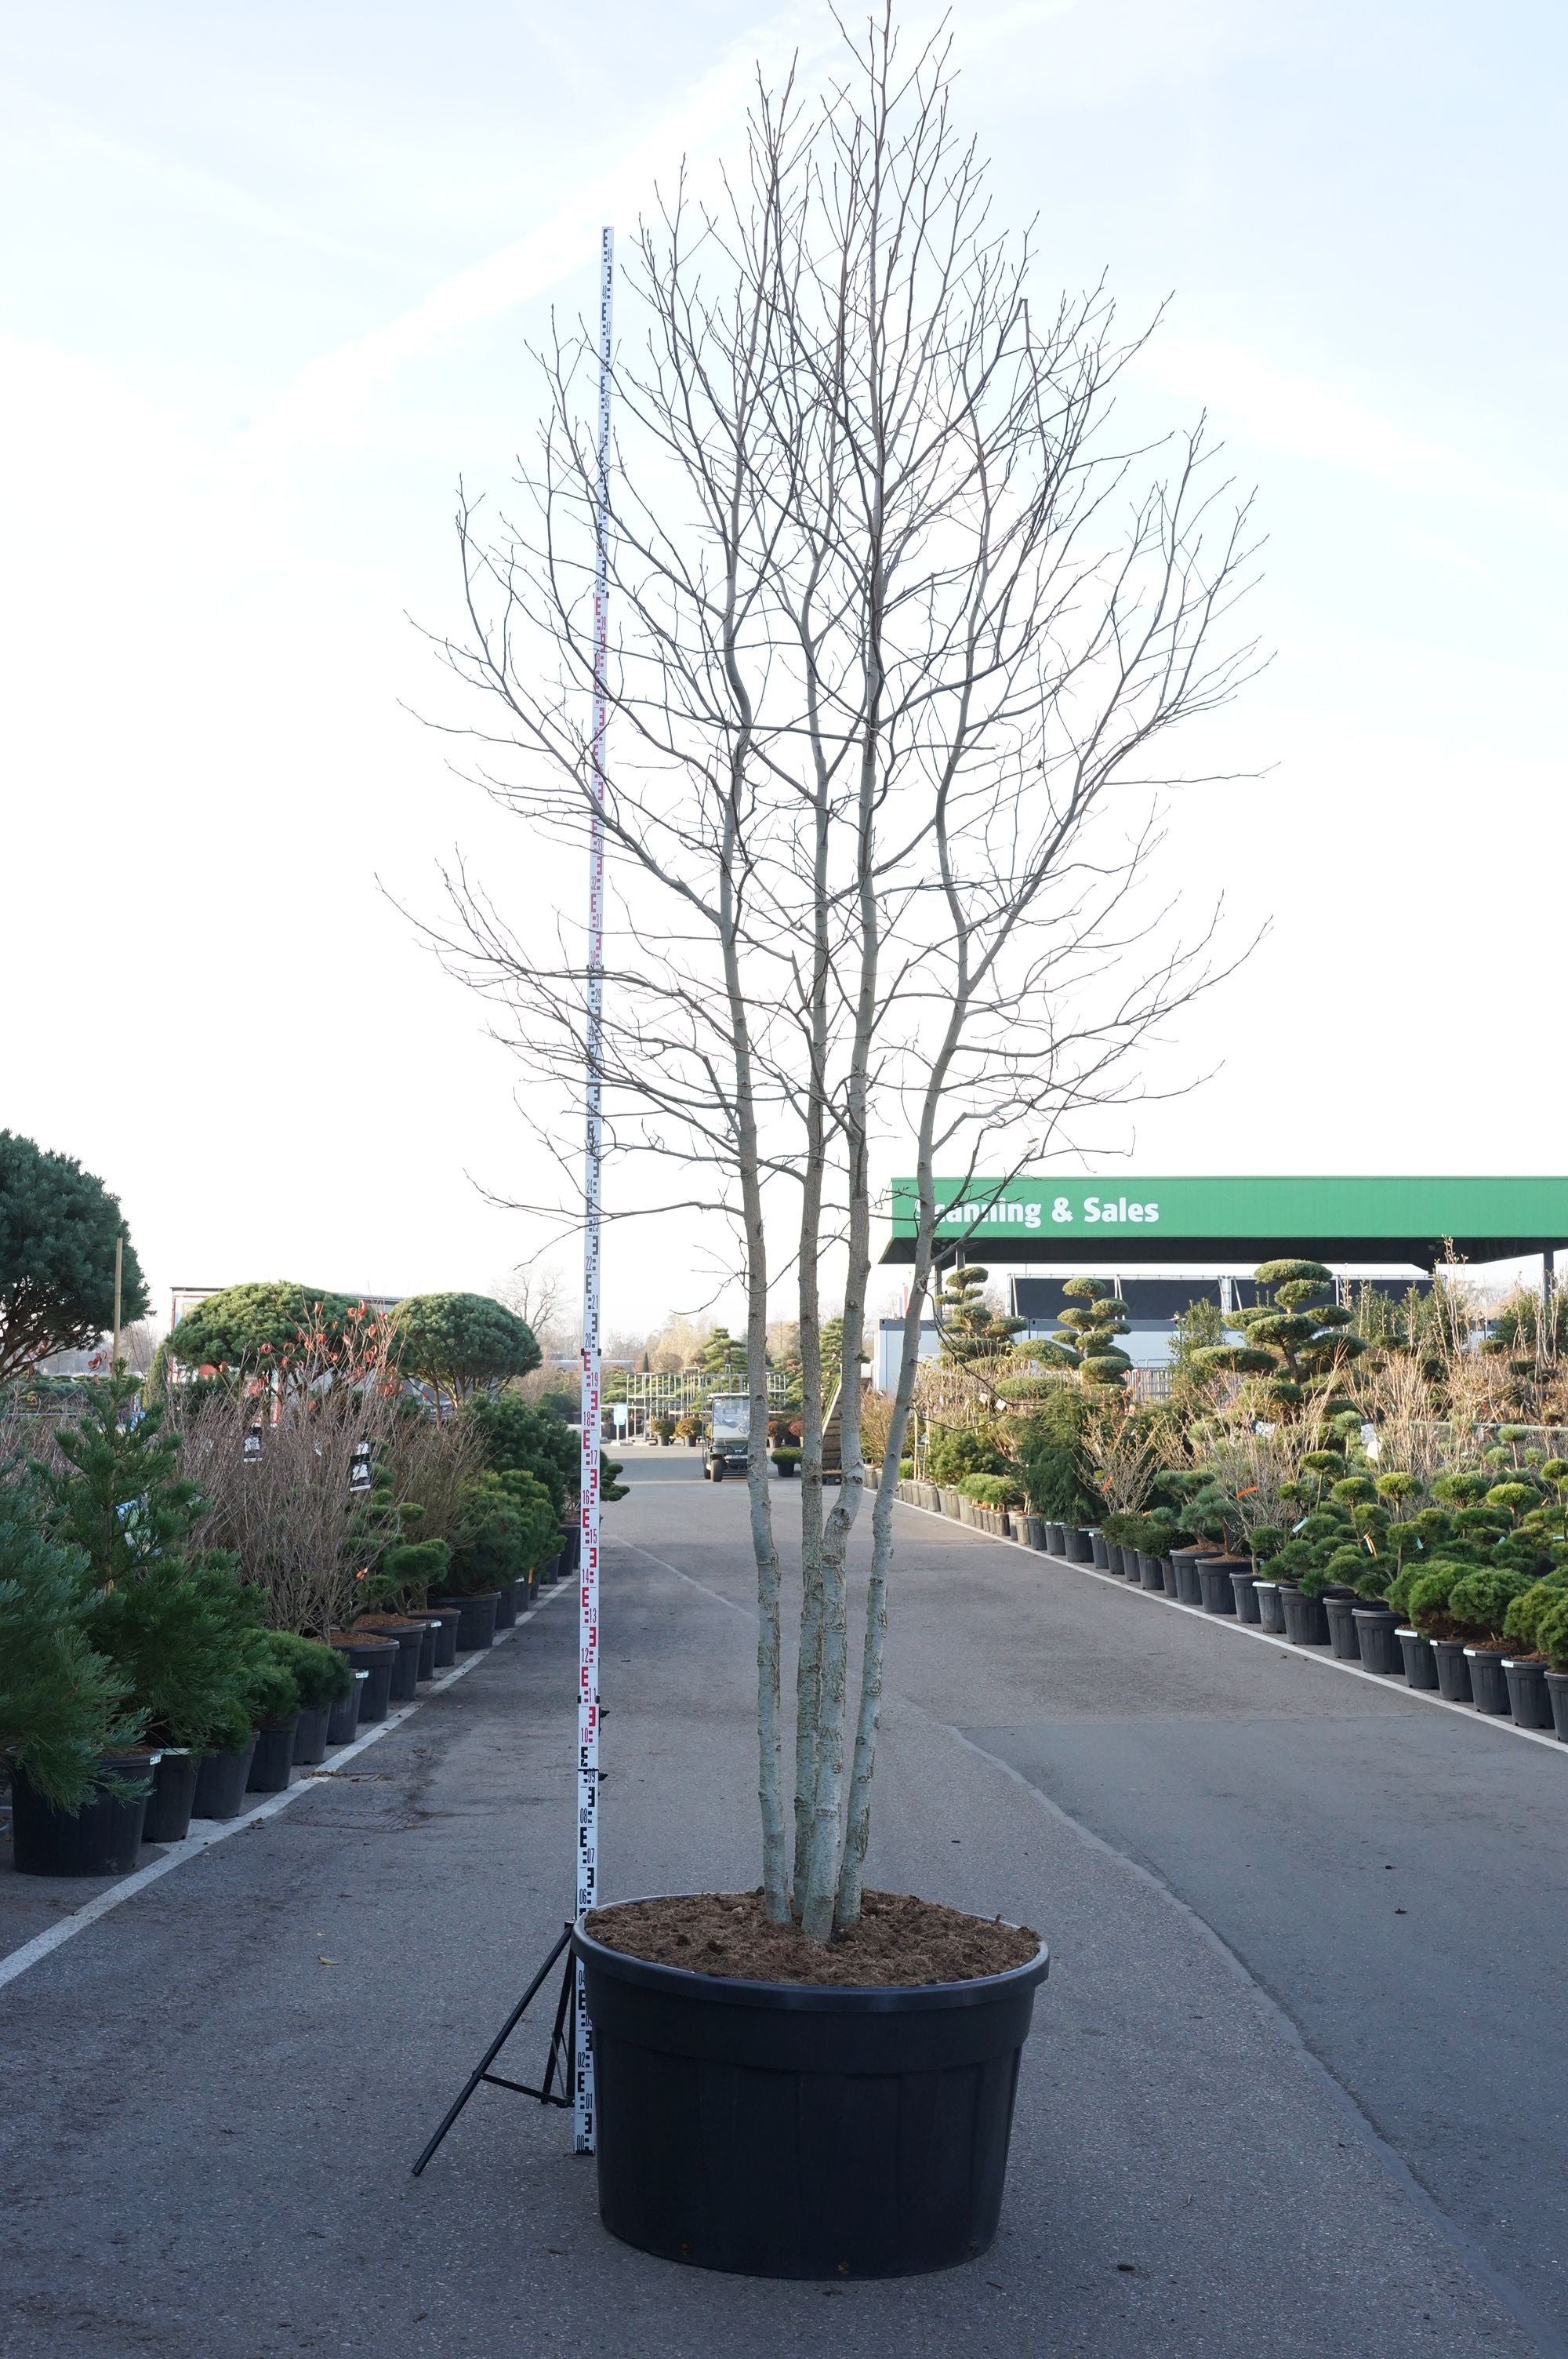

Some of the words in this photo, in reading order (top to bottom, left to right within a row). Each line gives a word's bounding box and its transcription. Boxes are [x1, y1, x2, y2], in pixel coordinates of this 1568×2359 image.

[591, 876, 596, 890] 32
[597, 914, 601, 928] 31
[595, 988, 601, 1002] 29
[586, 1179, 592, 1194] 24
[1051, 1198, 1073, 1222] &
[1083, 1198, 1159, 1223] Sales
[593, 1217, 598, 1232] 23
[586, 1256, 592, 1270] 22
[592, 1294, 598, 1309] 21
[585, 1332, 591, 1348] 20
[591, 1372, 597, 1387] 19
[583, 1411, 590, 1427] 18
[590, 1450, 597, 1465] 17
[583, 1489, 590, 1504] 16
[590, 1528, 597, 1543] 15
[582, 1568, 589, 1583] 14
[590, 1608, 596, 1623] 13
[582, 1648, 588, 1663] 12
[589, 1688, 596, 1703] 11
[581, 1727, 588, 1743] 10
[588, 1768, 595, 1783] 09
[580, 1808, 587, 1823] 08
[587, 1848, 594, 1863] 07
[579, 1888, 586, 1904] 06
[578, 2052, 585, 2067] 02
[586, 2093, 593, 2109] 01
[577, 2134, 584, 2150] 00
